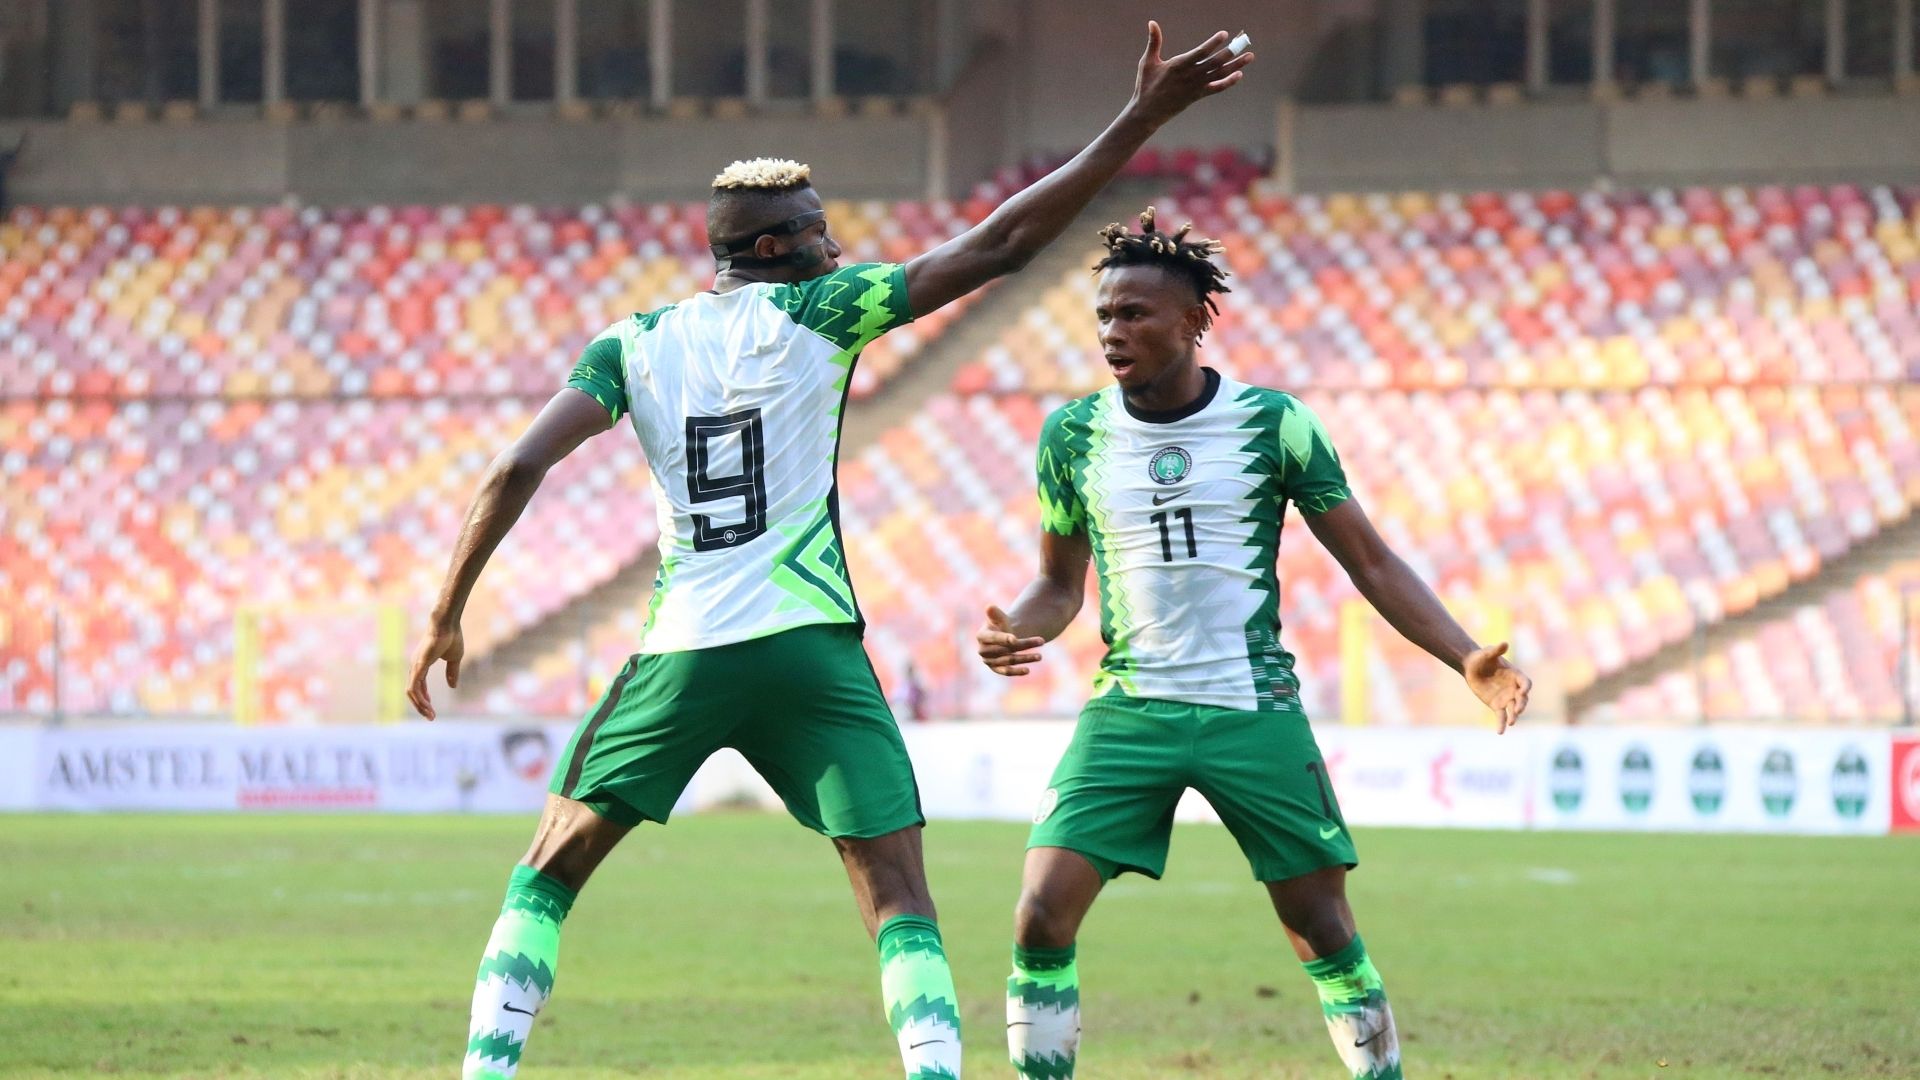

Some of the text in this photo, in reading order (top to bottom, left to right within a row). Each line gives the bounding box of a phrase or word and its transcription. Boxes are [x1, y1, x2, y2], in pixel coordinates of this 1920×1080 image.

[686, 408, 767, 552] 9
[1152, 447, 1179, 463] FOOTBALL
[1150, 507, 1197, 562] 11
[48, 746, 223, 791] AMSTEL
[236, 746, 378, 788] MALTA
